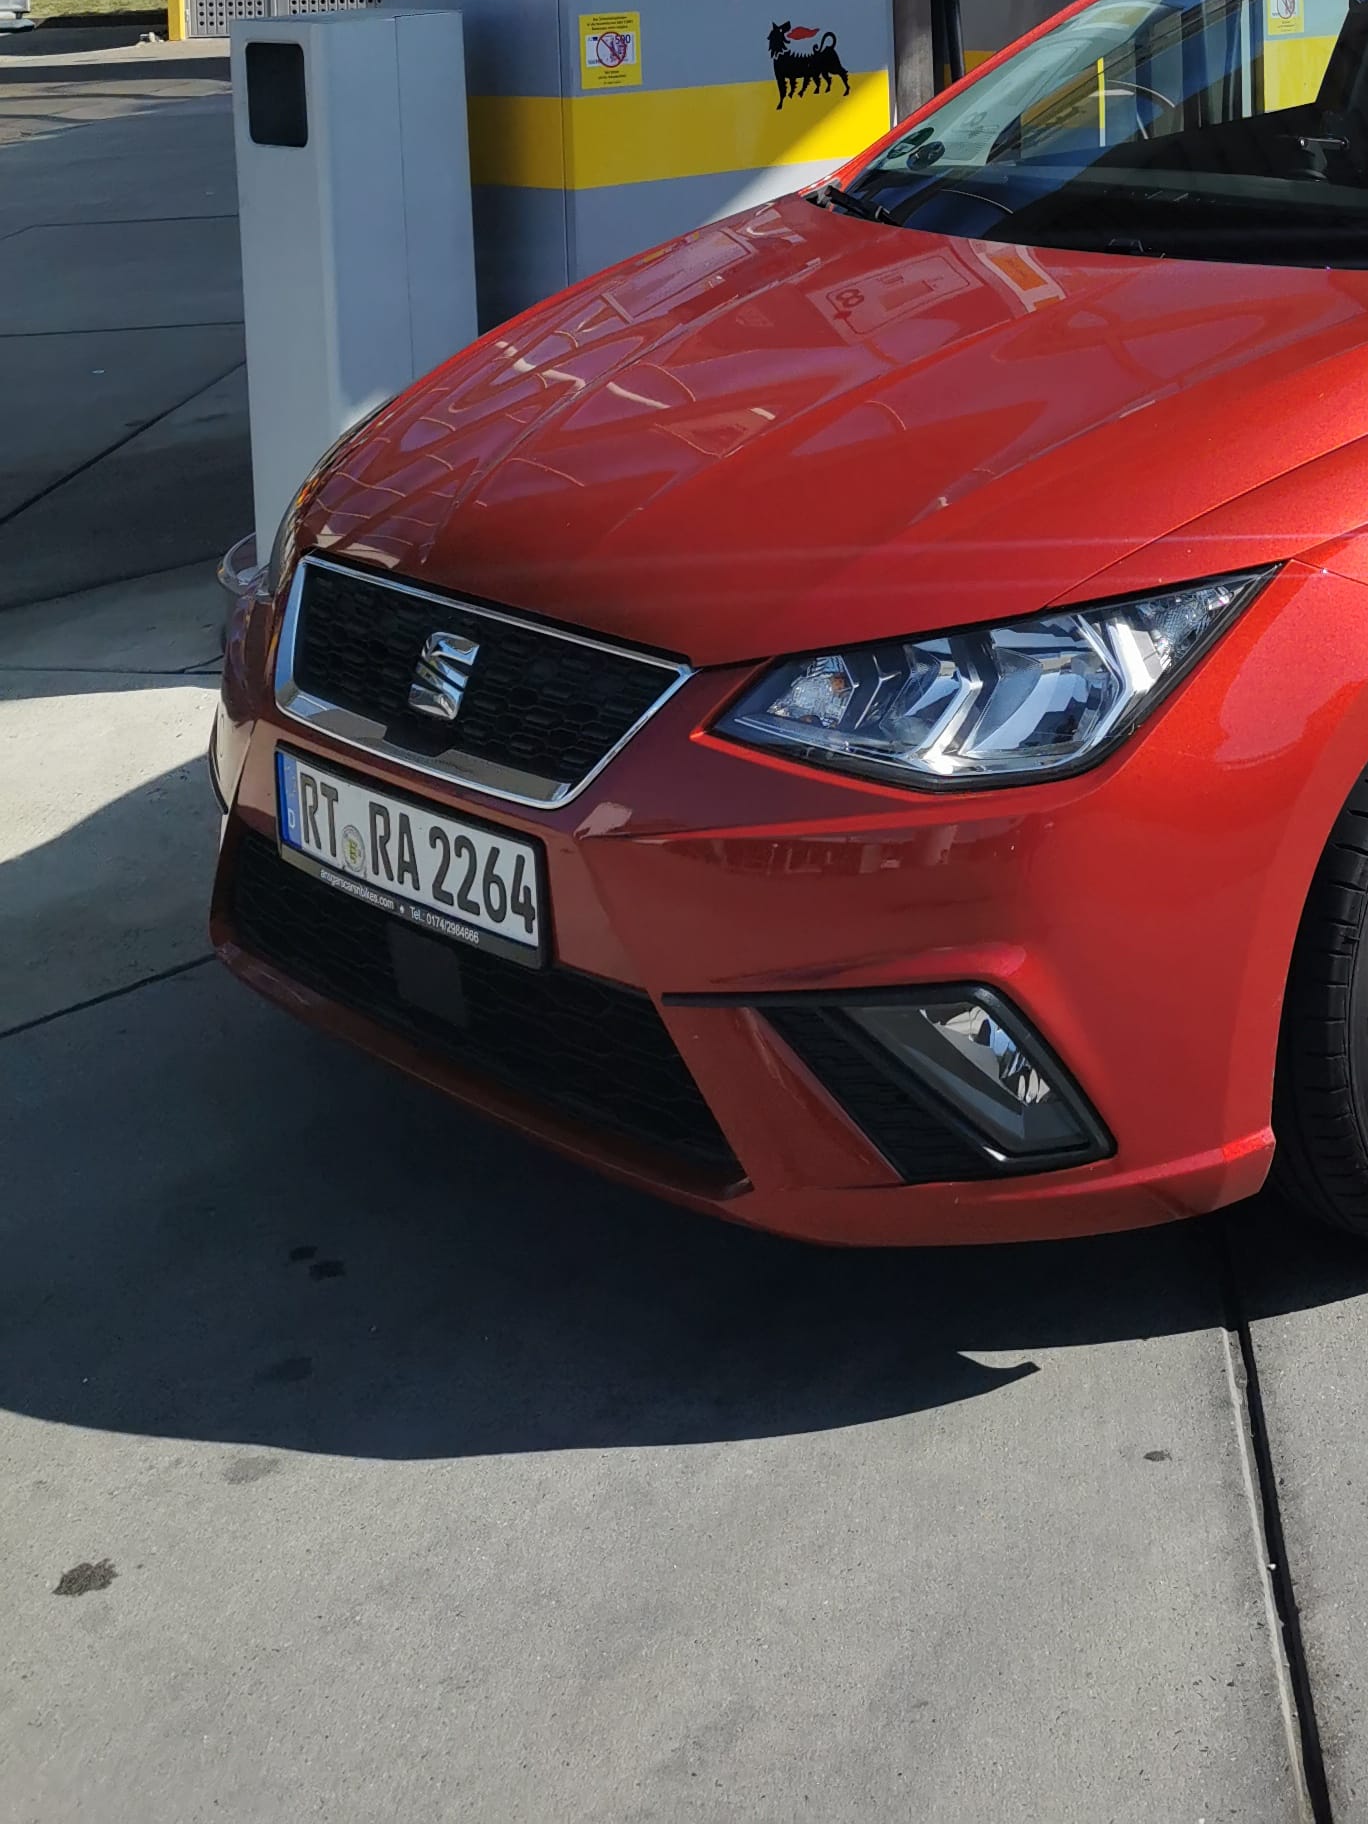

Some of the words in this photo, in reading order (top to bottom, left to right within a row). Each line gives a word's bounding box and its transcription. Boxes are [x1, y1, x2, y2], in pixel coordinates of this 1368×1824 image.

[300, 771, 339, 858] RT
[369, 801, 421, 891] RA
[428, 825, 536, 934] 2264
